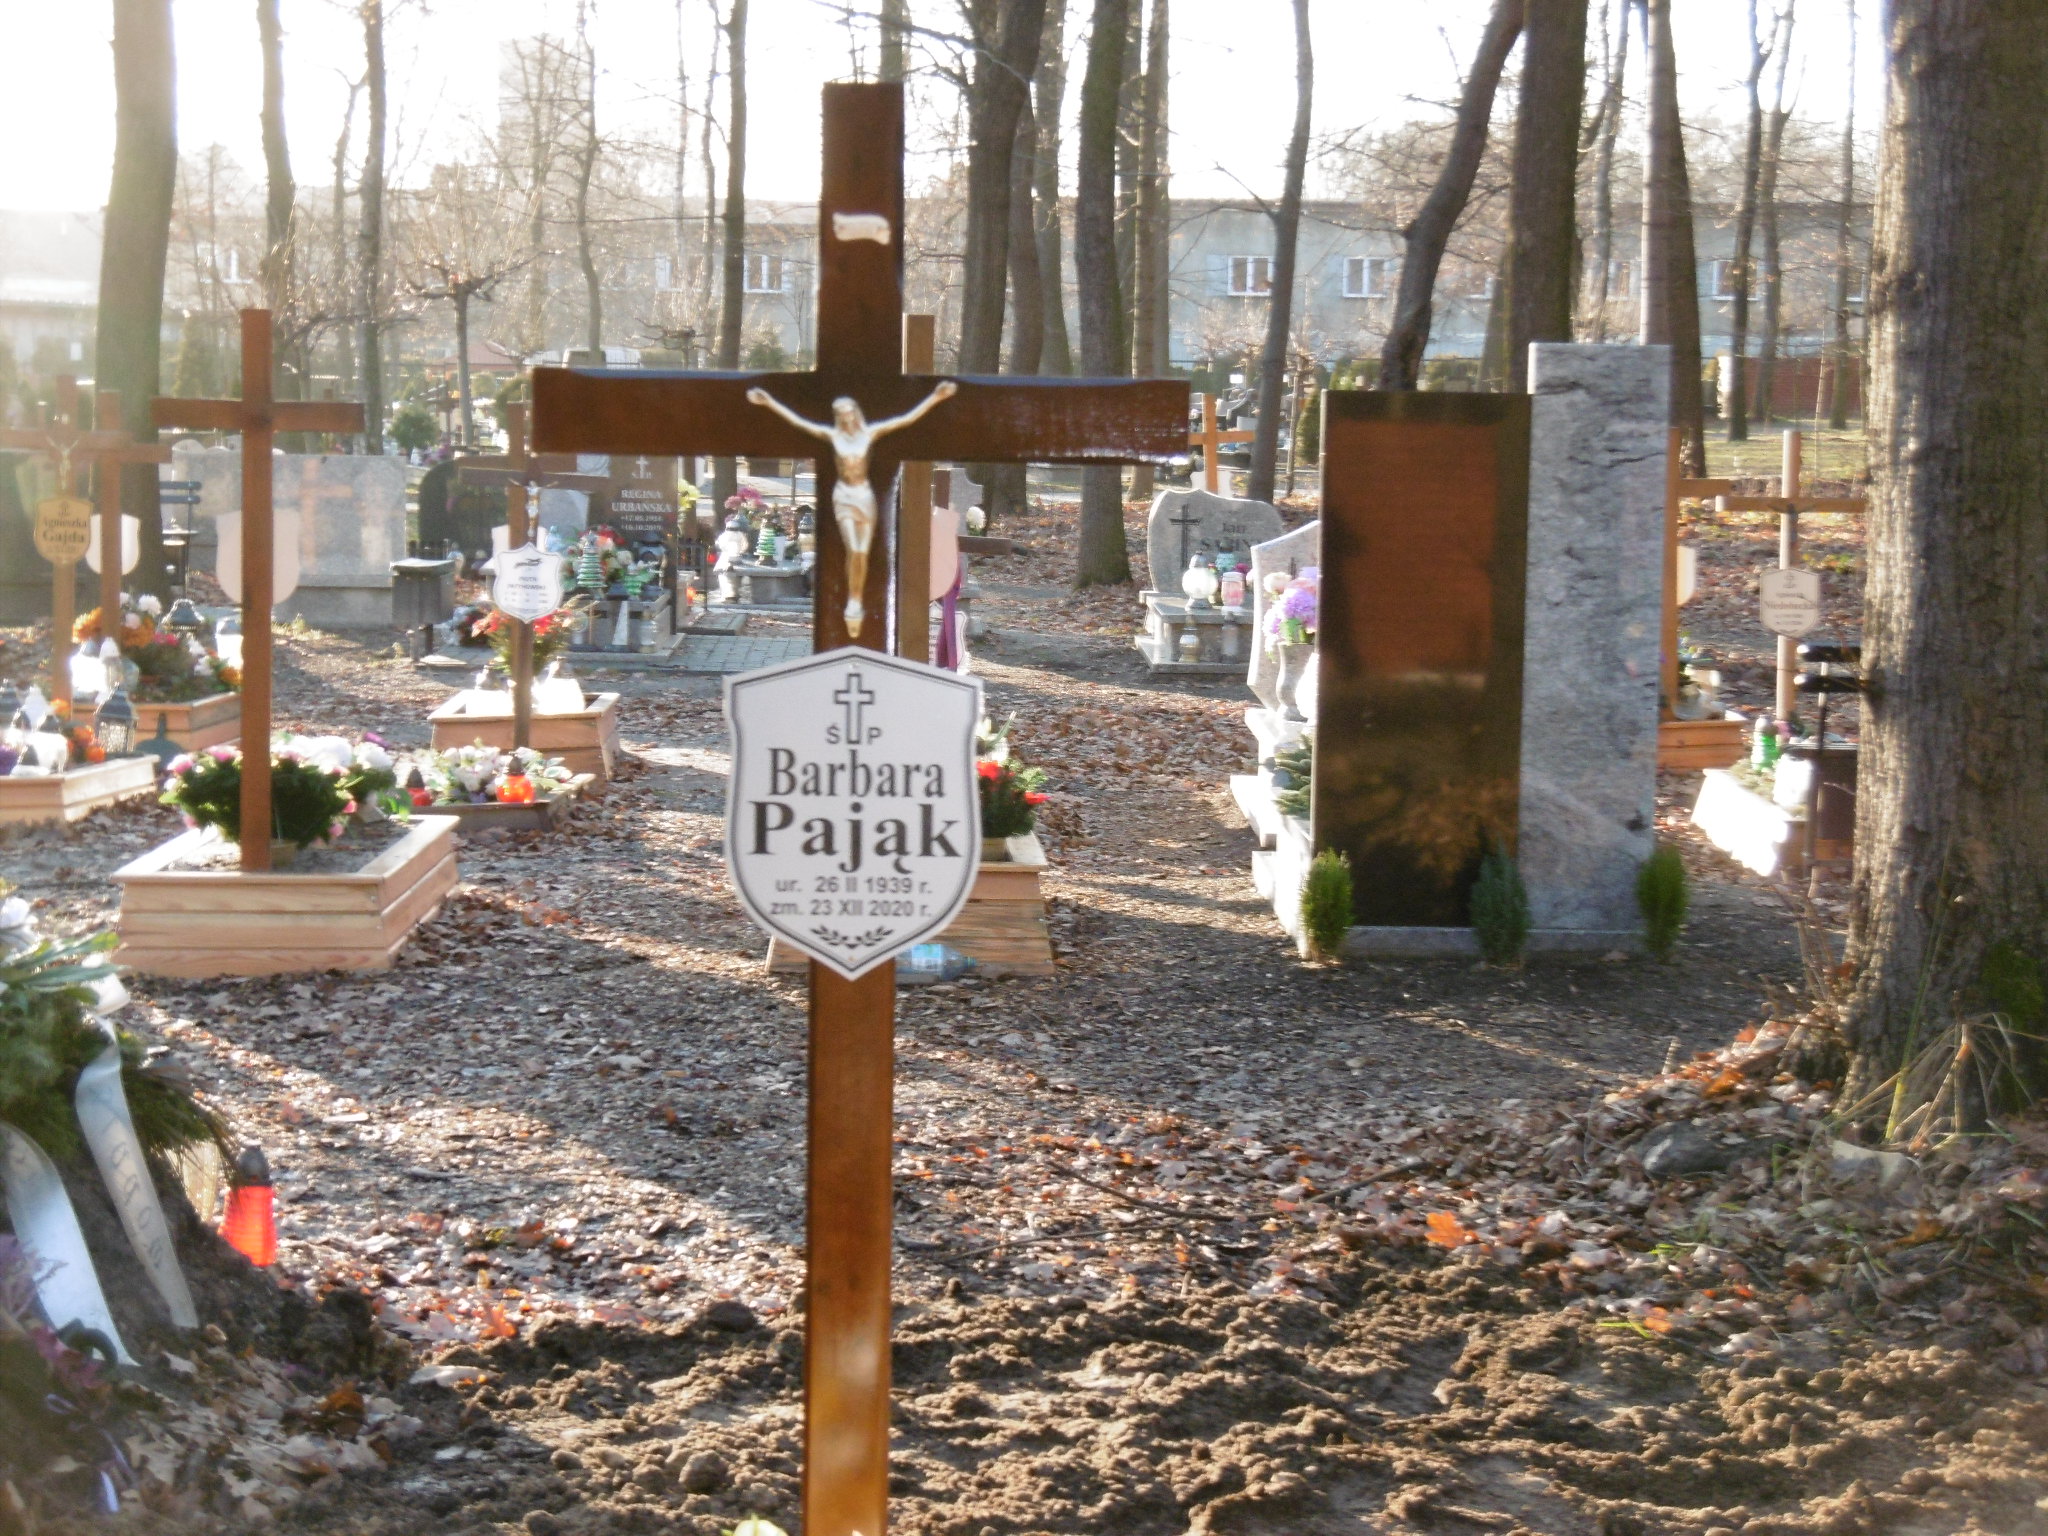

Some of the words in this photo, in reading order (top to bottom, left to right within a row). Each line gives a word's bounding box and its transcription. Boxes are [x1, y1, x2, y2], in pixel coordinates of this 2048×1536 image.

[867, 727, 881, 745] P
[768, 748, 946, 799] Barbara
[747, 800, 962, 874] Pająk
[775, 878, 803, 893] ur.
[815, 876, 839, 893] 26
[845, 876, 858, 893] II
[866, 877, 913, 894] 1939
[919, 880, 932, 894] r.
[770, 902, 803, 916] zm.
[810, 900, 832, 916] 23
[838, 900, 863, 917] XII
[869, 900, 915, 917] 2020
[919, 903, 932, 917] r.
